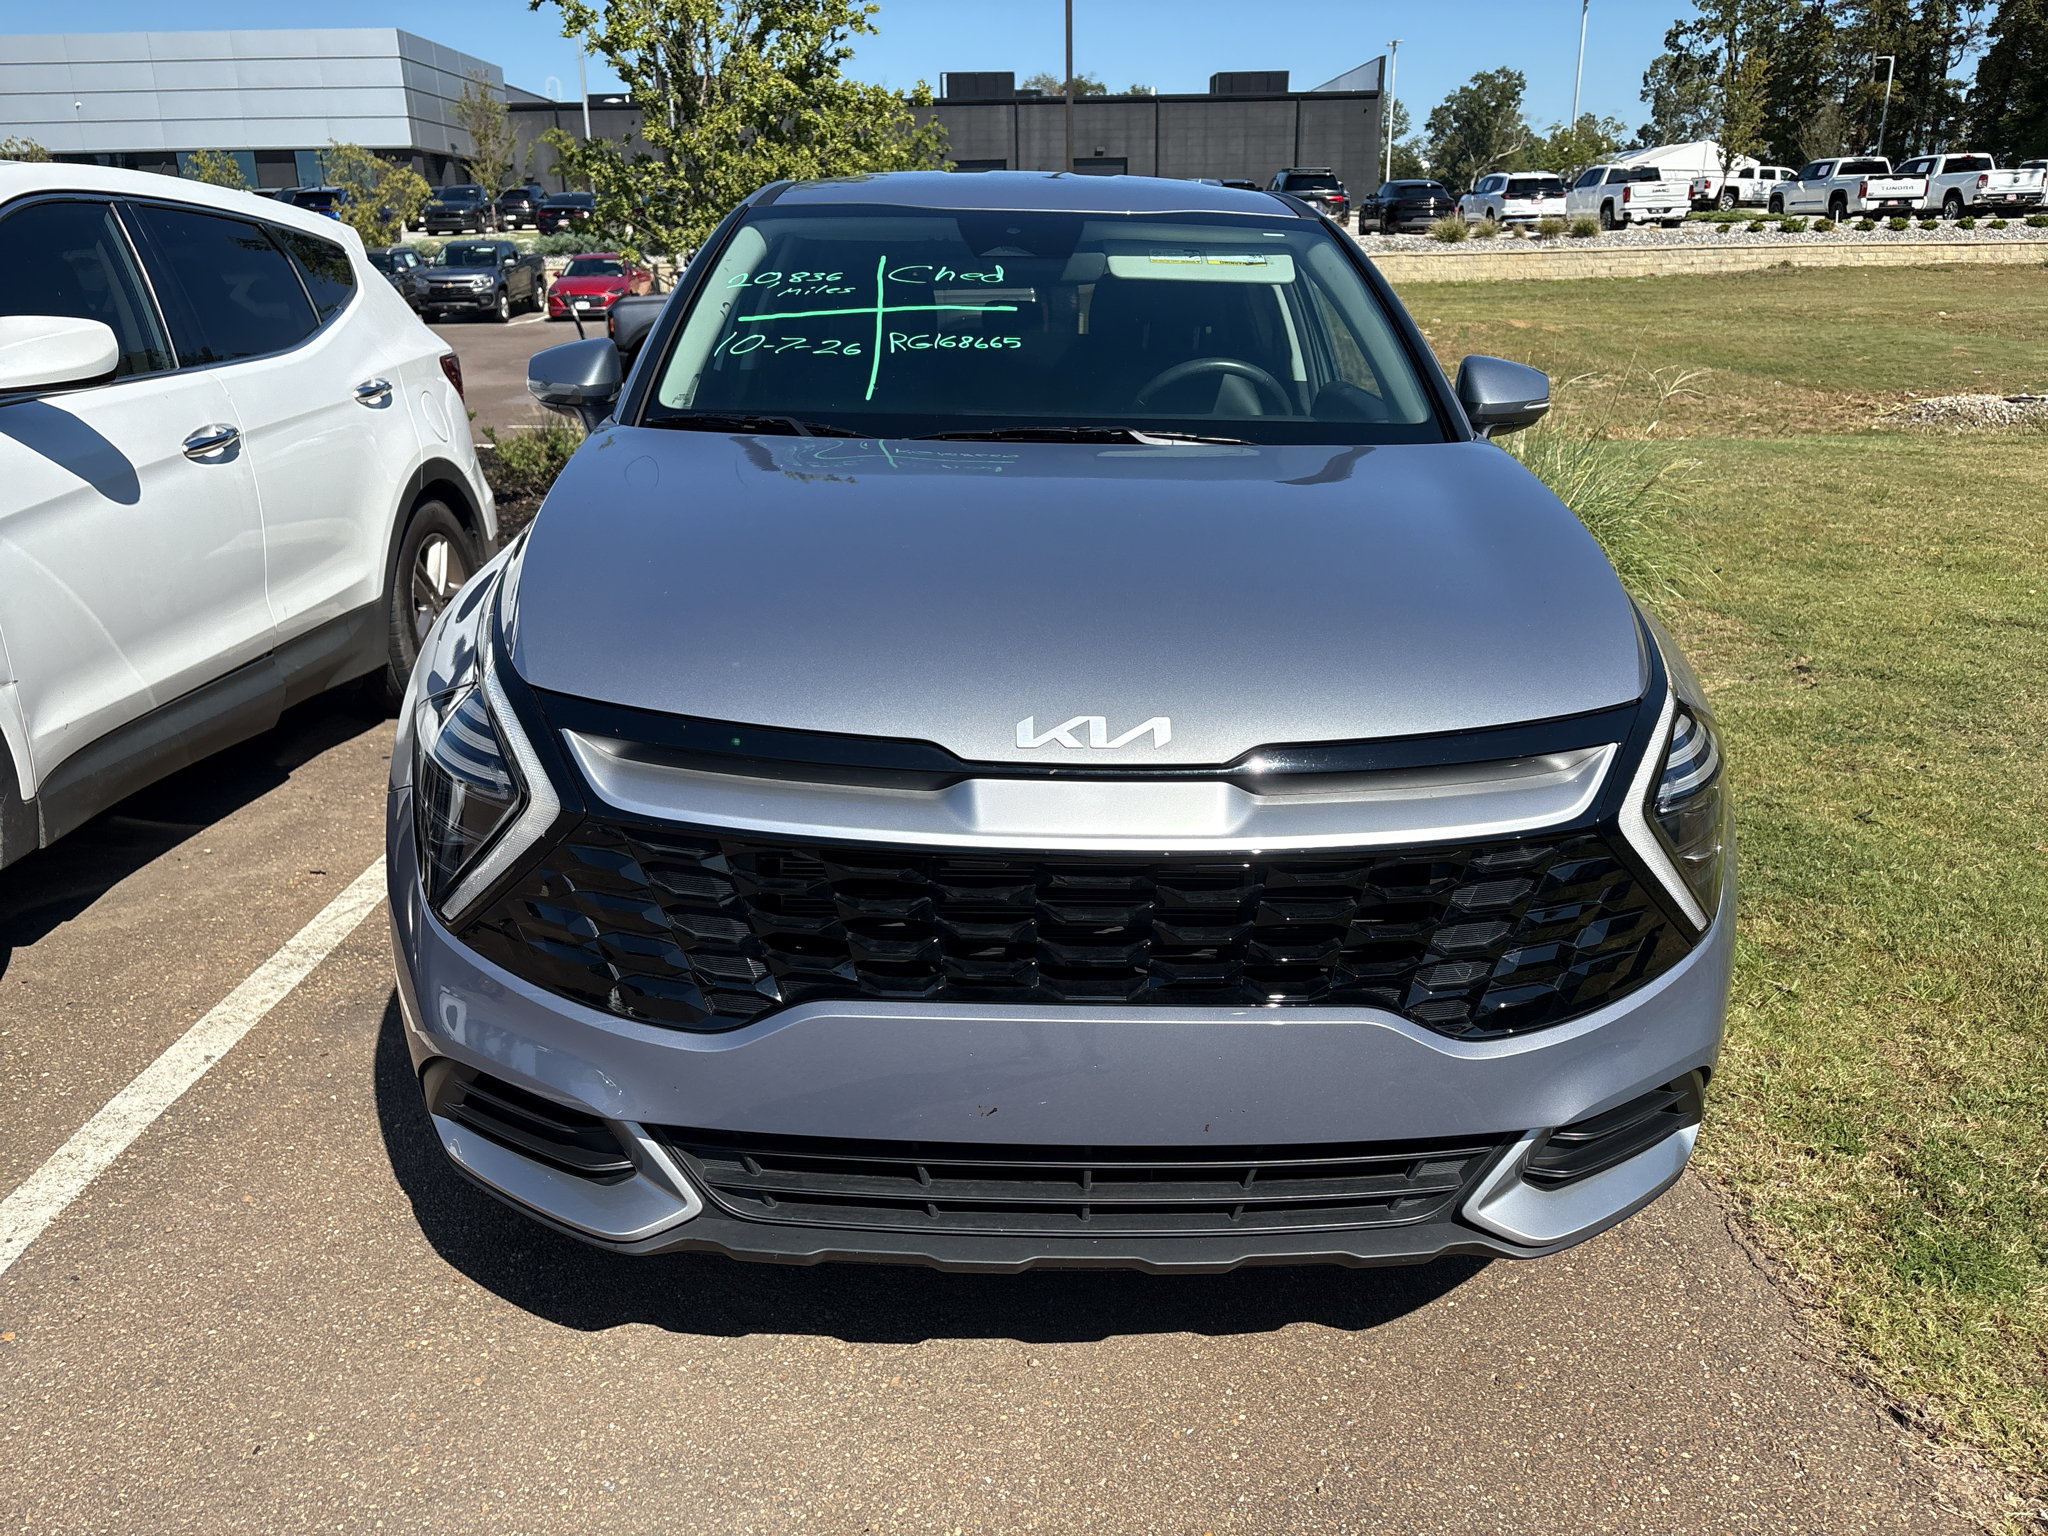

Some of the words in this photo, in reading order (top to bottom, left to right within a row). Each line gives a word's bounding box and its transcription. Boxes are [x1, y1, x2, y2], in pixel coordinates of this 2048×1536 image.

[726, 271, 844, 289] 20,836
[888, 264, 1005, 284] Ched
[713, 331, 862, 357] 10-7-26
[888, 331, 1022, 354] RG168665
[1016, 715, 1172, 750] KIA
